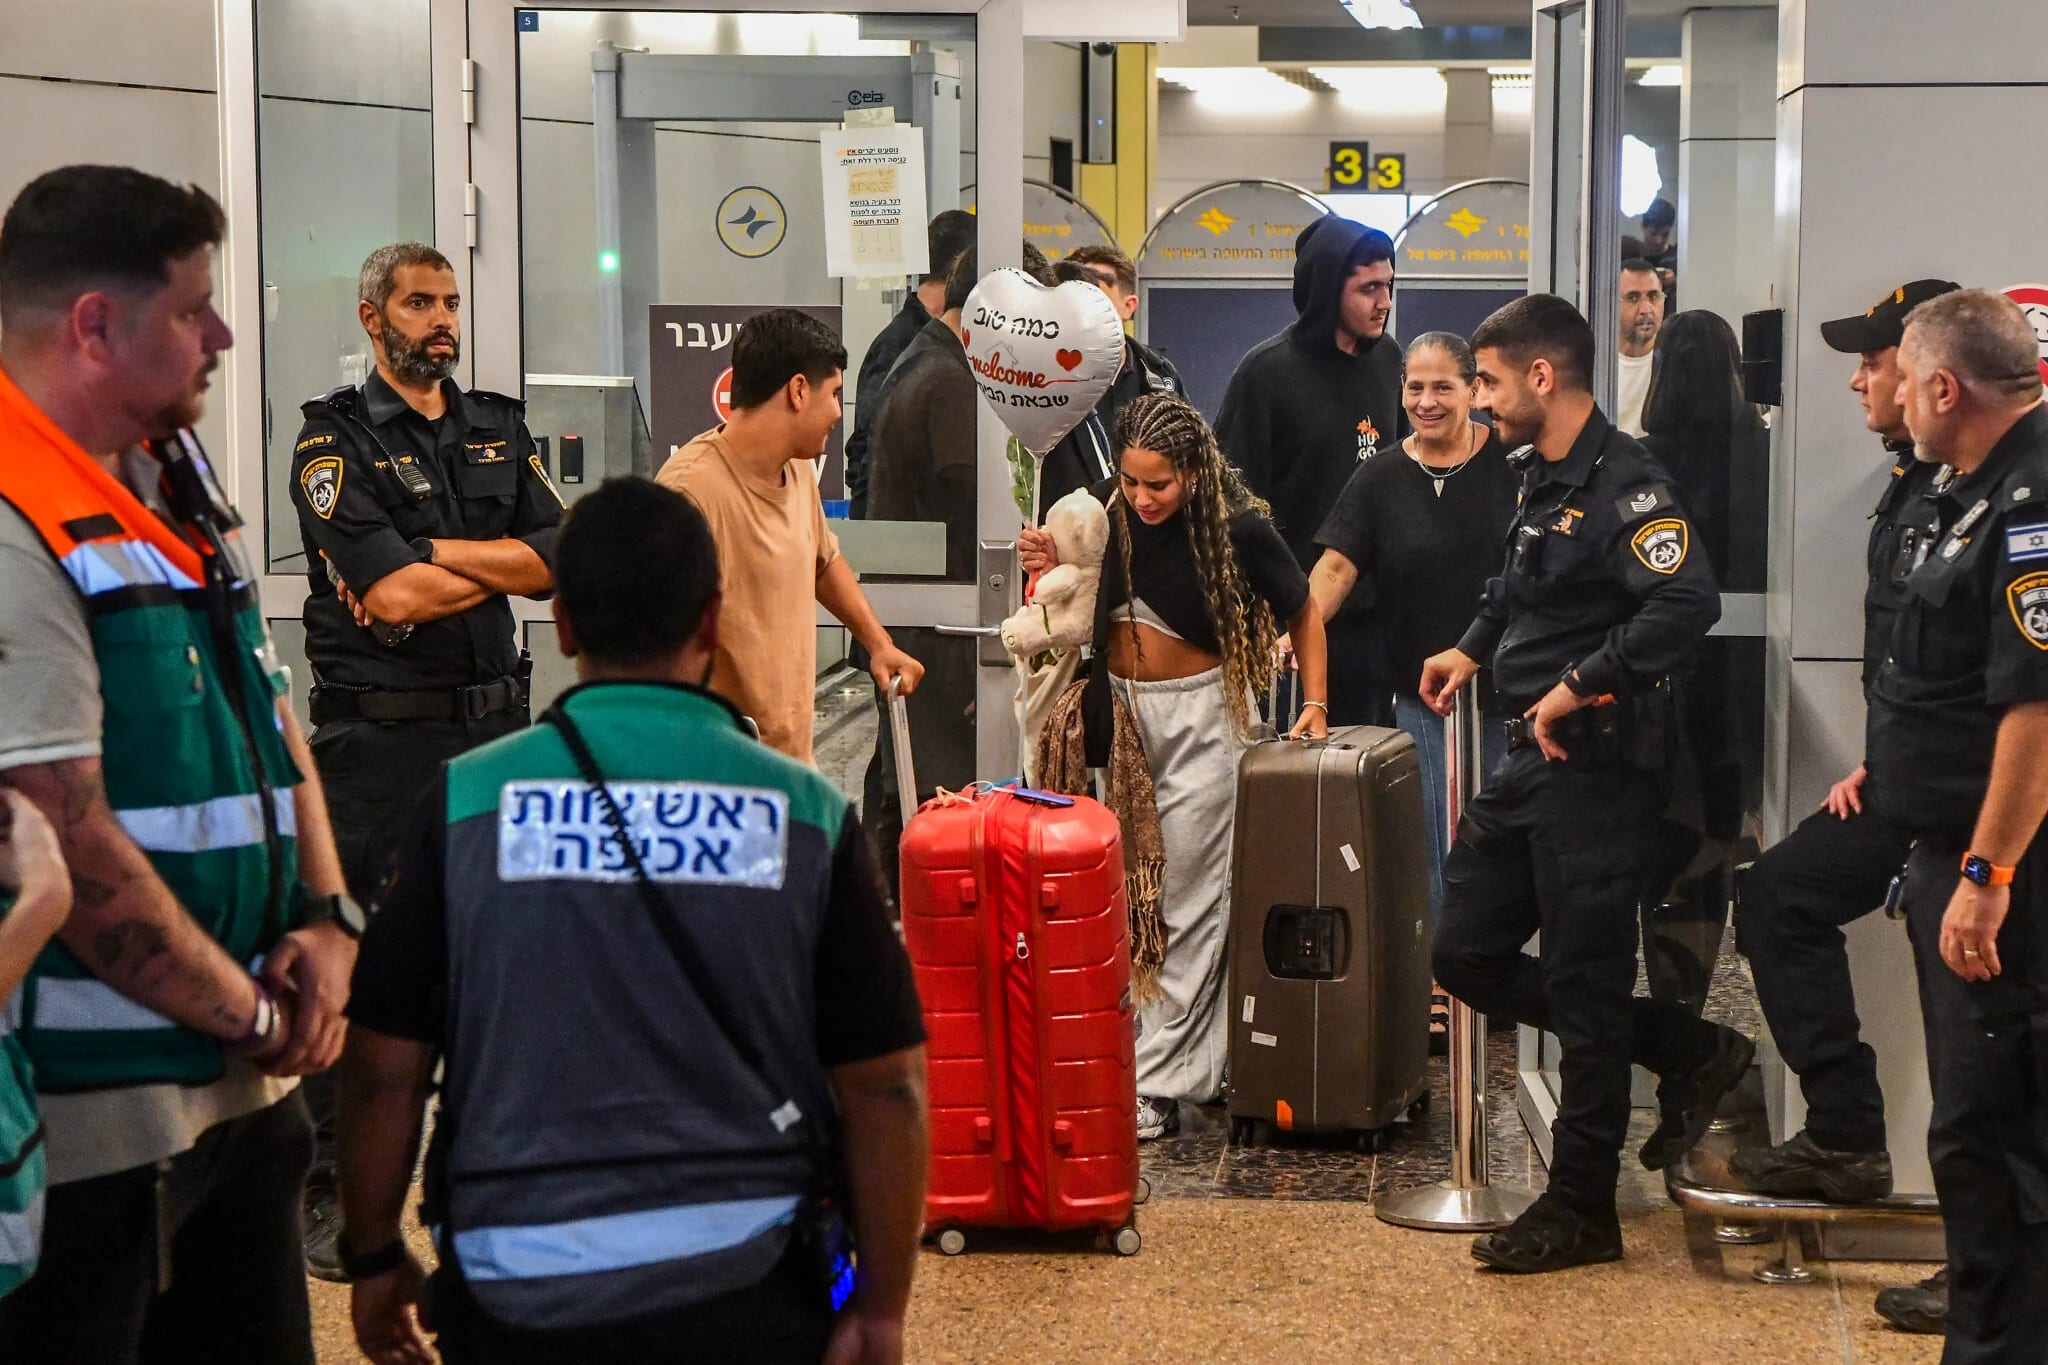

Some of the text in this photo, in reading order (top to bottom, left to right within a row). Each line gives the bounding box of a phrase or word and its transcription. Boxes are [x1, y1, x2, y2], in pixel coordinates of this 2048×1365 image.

[525, 17, 531, 25] 5
[858, 156, 871, 164] דלת
[1334, 148, 1363, 185] 3
[1378, 157, 1402, 189] 3
[853, 217, 899, 226] לחברת תעופה
[1159, 245, 1207, 260] בישראל
[1213, 247, 1264, 260] התעופה
[973, 307, 1060, 339] כמה טוב
[666, 322, 743, 351] עבר
[969, 351, 1054, 389] welcome
[1010, 394, 1069, 408] שבאת
[1358, 433, 1376, 447] HU
[656, 791, 778, 833] ראש
[555, 834, 730, 875] אכיפה
